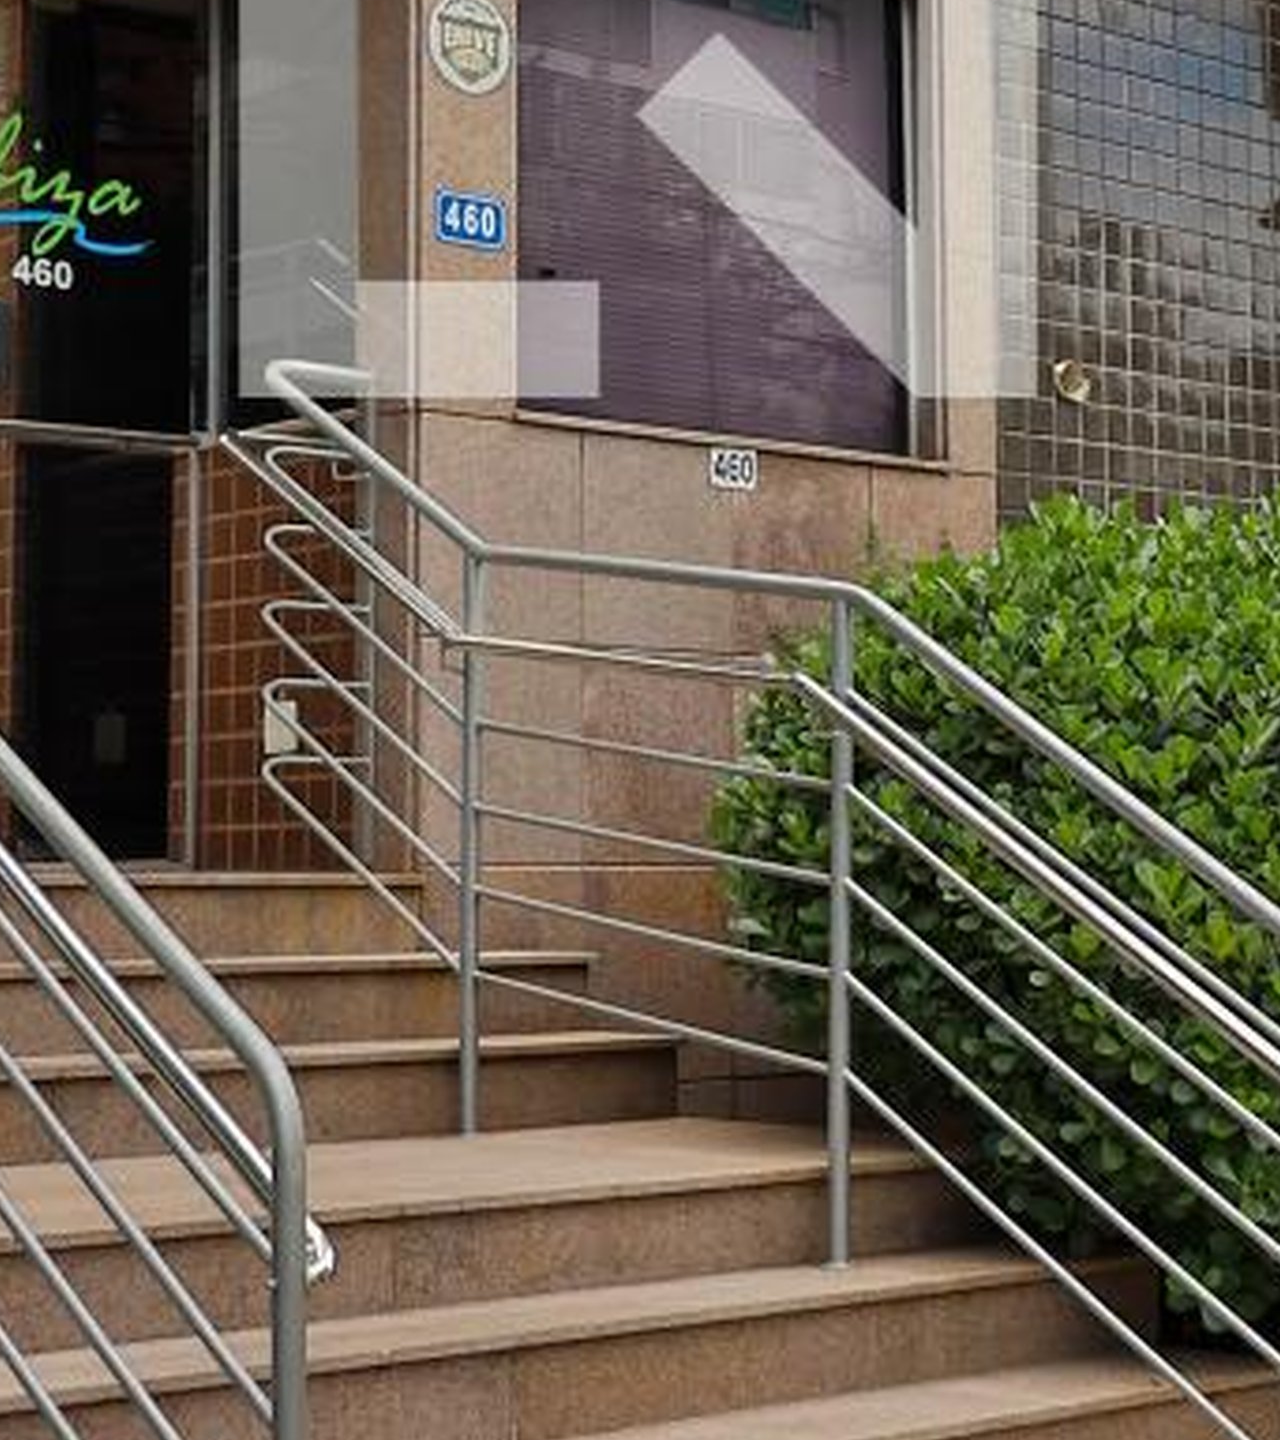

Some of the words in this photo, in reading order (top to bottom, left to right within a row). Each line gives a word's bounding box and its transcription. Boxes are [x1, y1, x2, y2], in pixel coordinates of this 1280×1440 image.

[445, 200, 496, 239] 460
[11, 253, 74, 290] 460
[714, 453, 754, 484] 460
